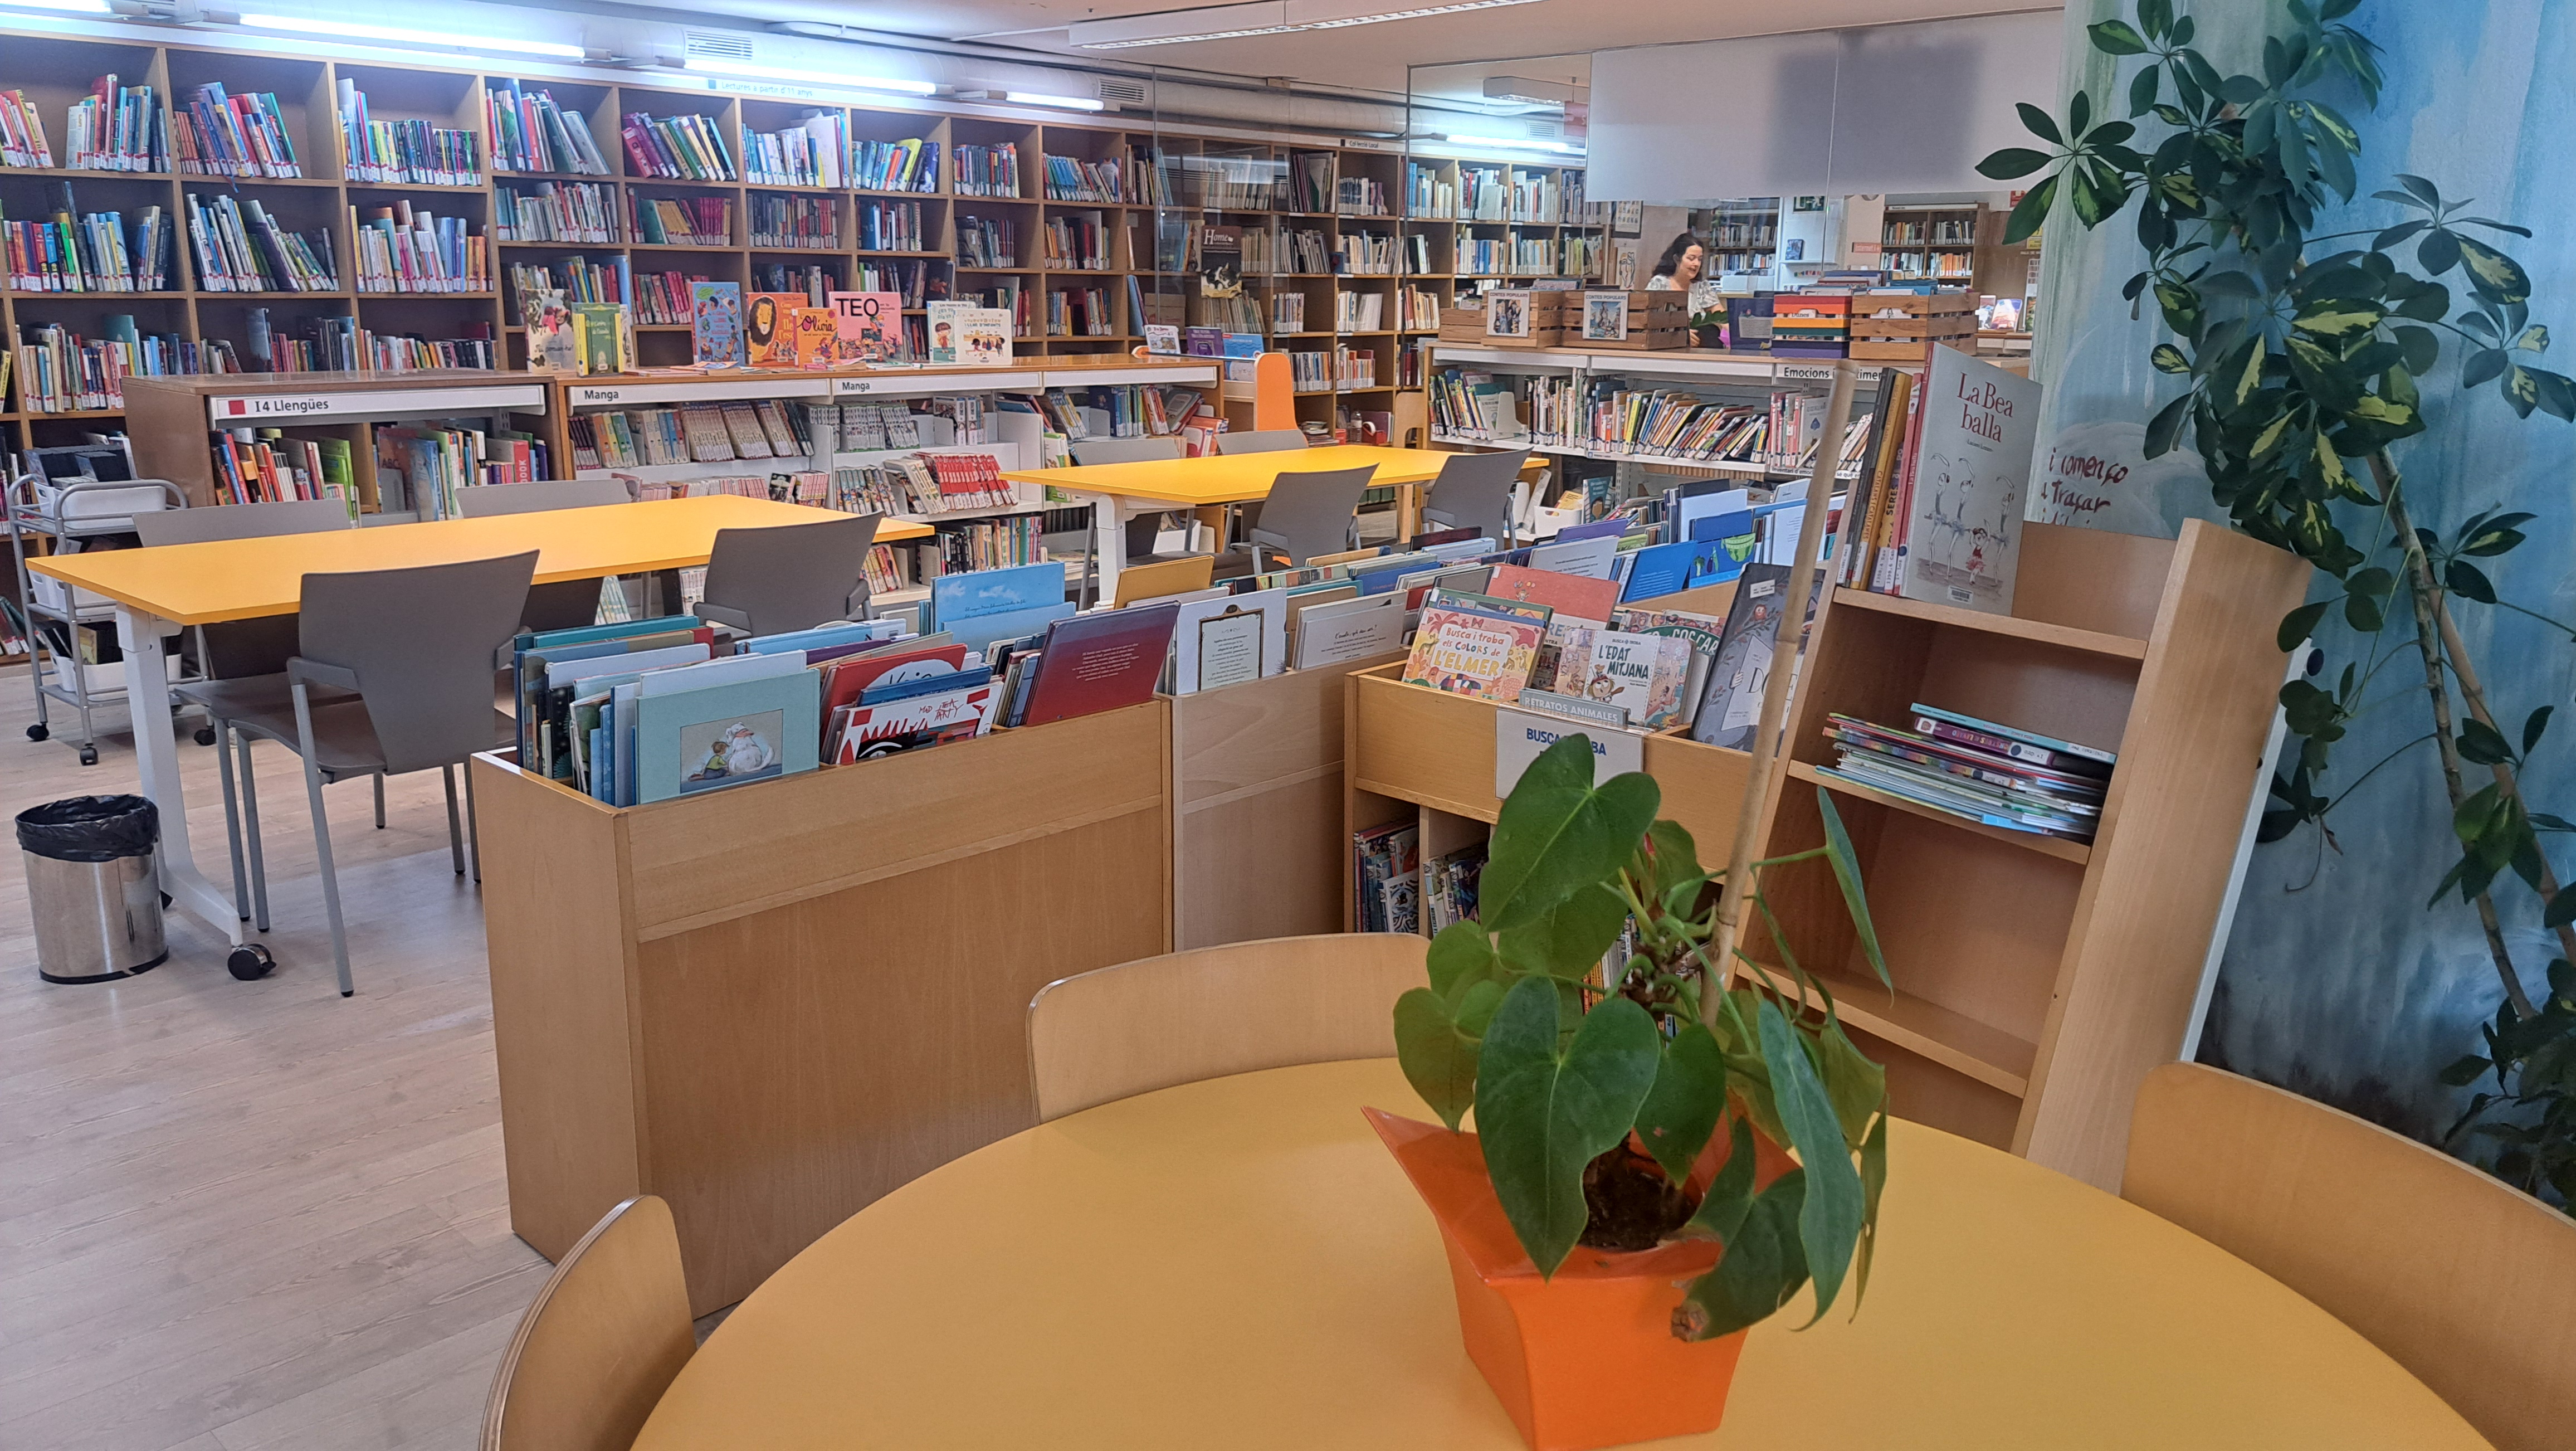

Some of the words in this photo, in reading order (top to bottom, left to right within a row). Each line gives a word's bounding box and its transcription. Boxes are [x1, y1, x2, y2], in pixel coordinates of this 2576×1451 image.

[1203, 229, 1228, 245] Home
[835, 298, 879, 317] TEO
[1784, 367, 1829, 378] Emocions
[584, 389, 619, 401] Manga
[842, 382, 870, 392] Manga
[1957, 371, 1980, 405] La
[1981, 381, 2013, 418] Bea
[274, 399, 329, 413] Llengües
[1961, 403, 2001, 442] balla
[1871, 470, 1884, 501] CATALANS
[1886, 485, 1899, 515] SERES
[1863, 507, 1875, 540] CATALANES
[1473, 632, 1477, 641] i
[1479, 633, 1504, 645] troba
[1598, 644, 1631, 661] L'EDAT
[1434, 650, 1500, 676] L'ELMER
[1607, 661, 1649, 680] MITJANA
[919, 705, 933, 714] MAD
[1525, 697, 1568, 712] RETRATOS
[1570, 705, 1618, 722] ANIMALES
